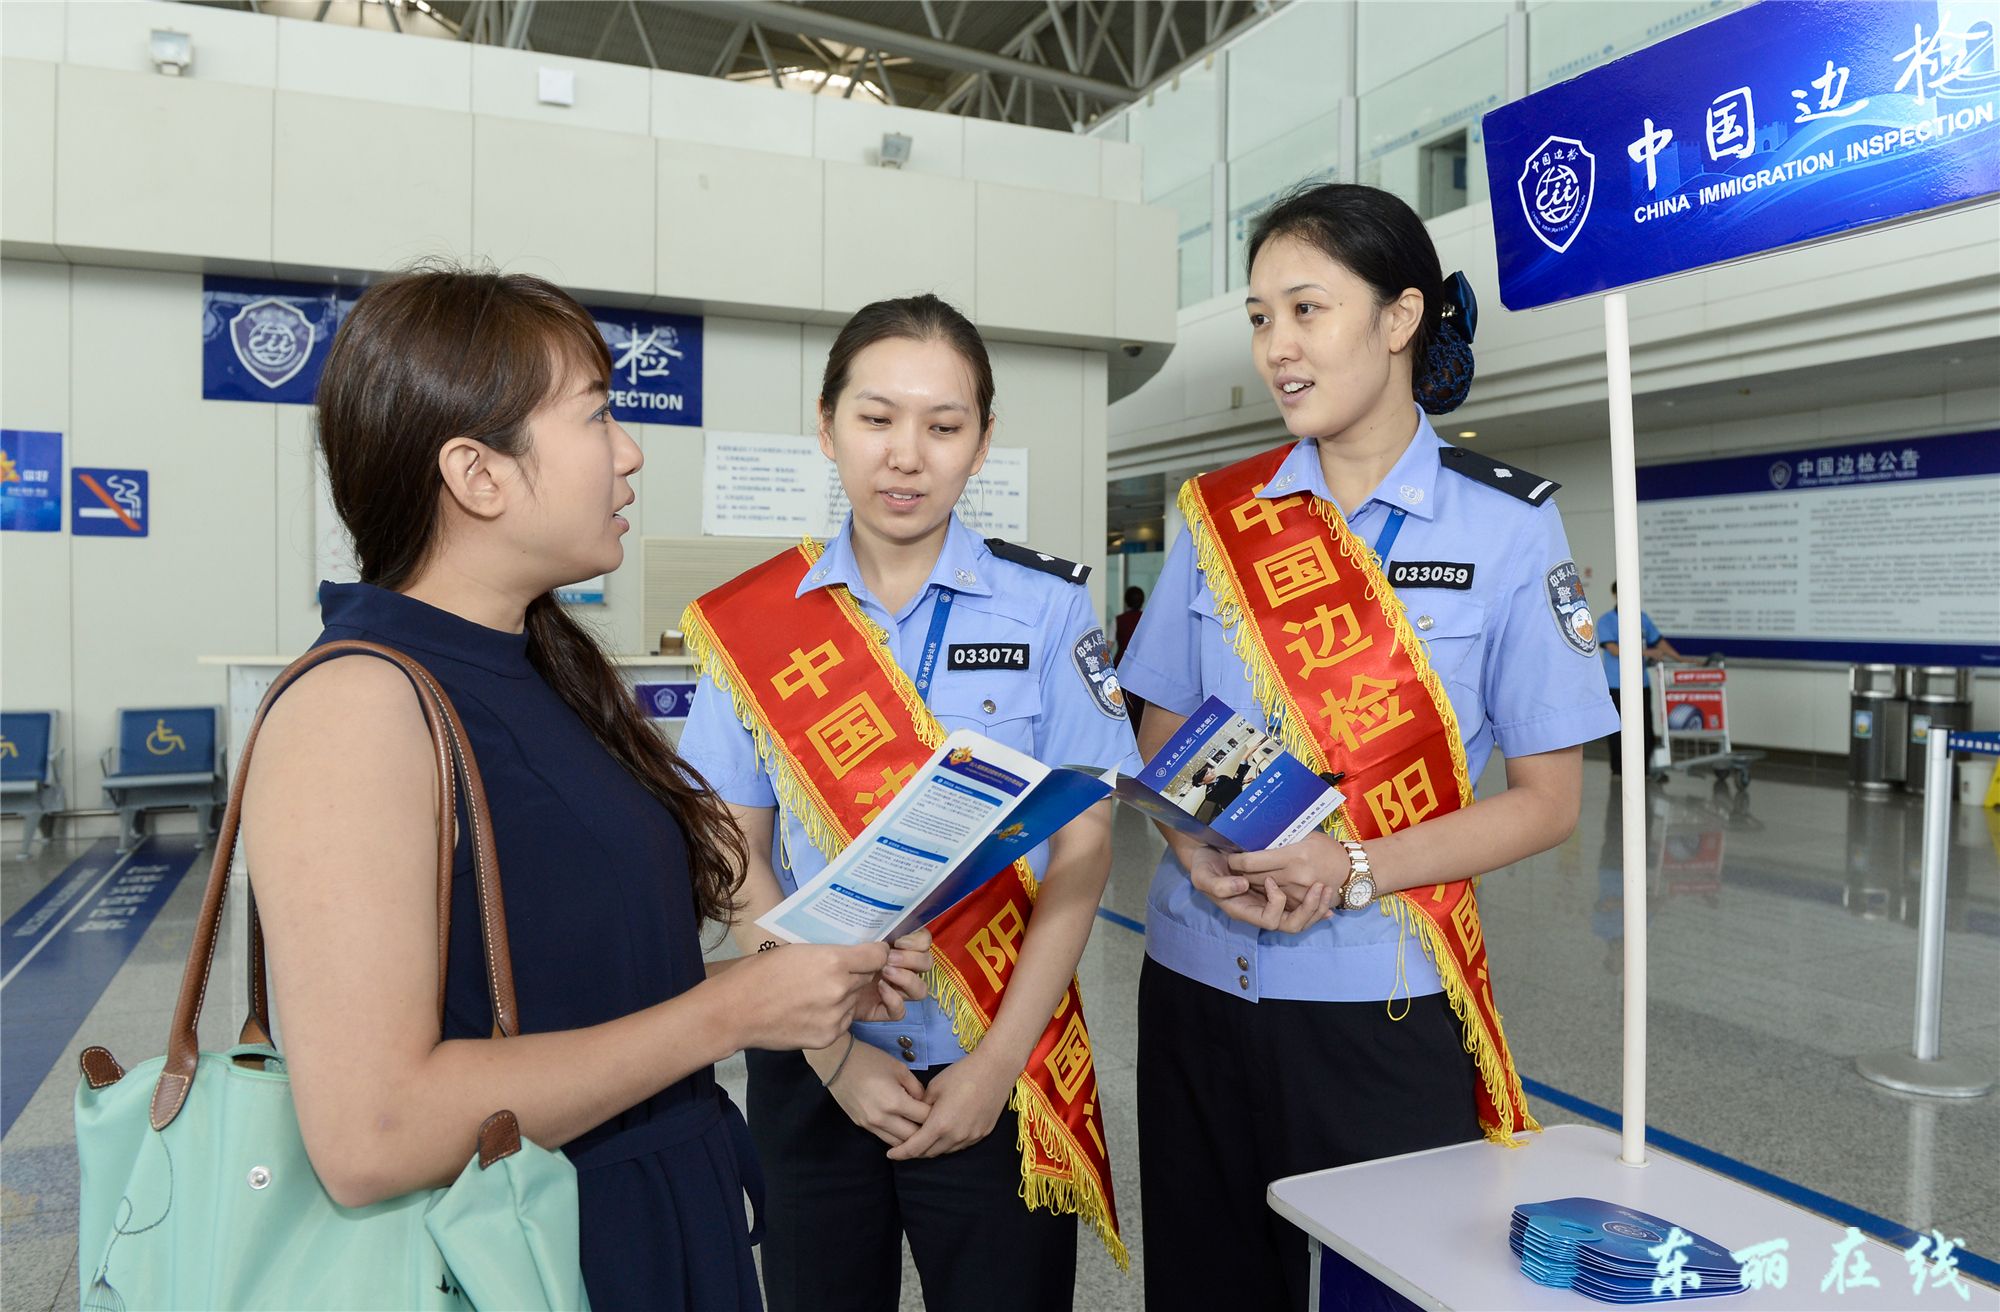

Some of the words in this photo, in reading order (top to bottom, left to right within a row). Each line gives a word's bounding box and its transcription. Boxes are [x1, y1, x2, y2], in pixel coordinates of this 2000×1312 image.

[1627, 12, 1990, 192] 中国边检
[1634, 194, 1691, 224] CHINA
[1699, 149, 1835, 204] IMMIGRATION
[1846, 101, 1995, 163] INSPECTION
[1797, 448, 1920, 479] 中国边检公告
[1395, 566, 1468, 583] 033059
[954, 649, 1024, 665] 033074
